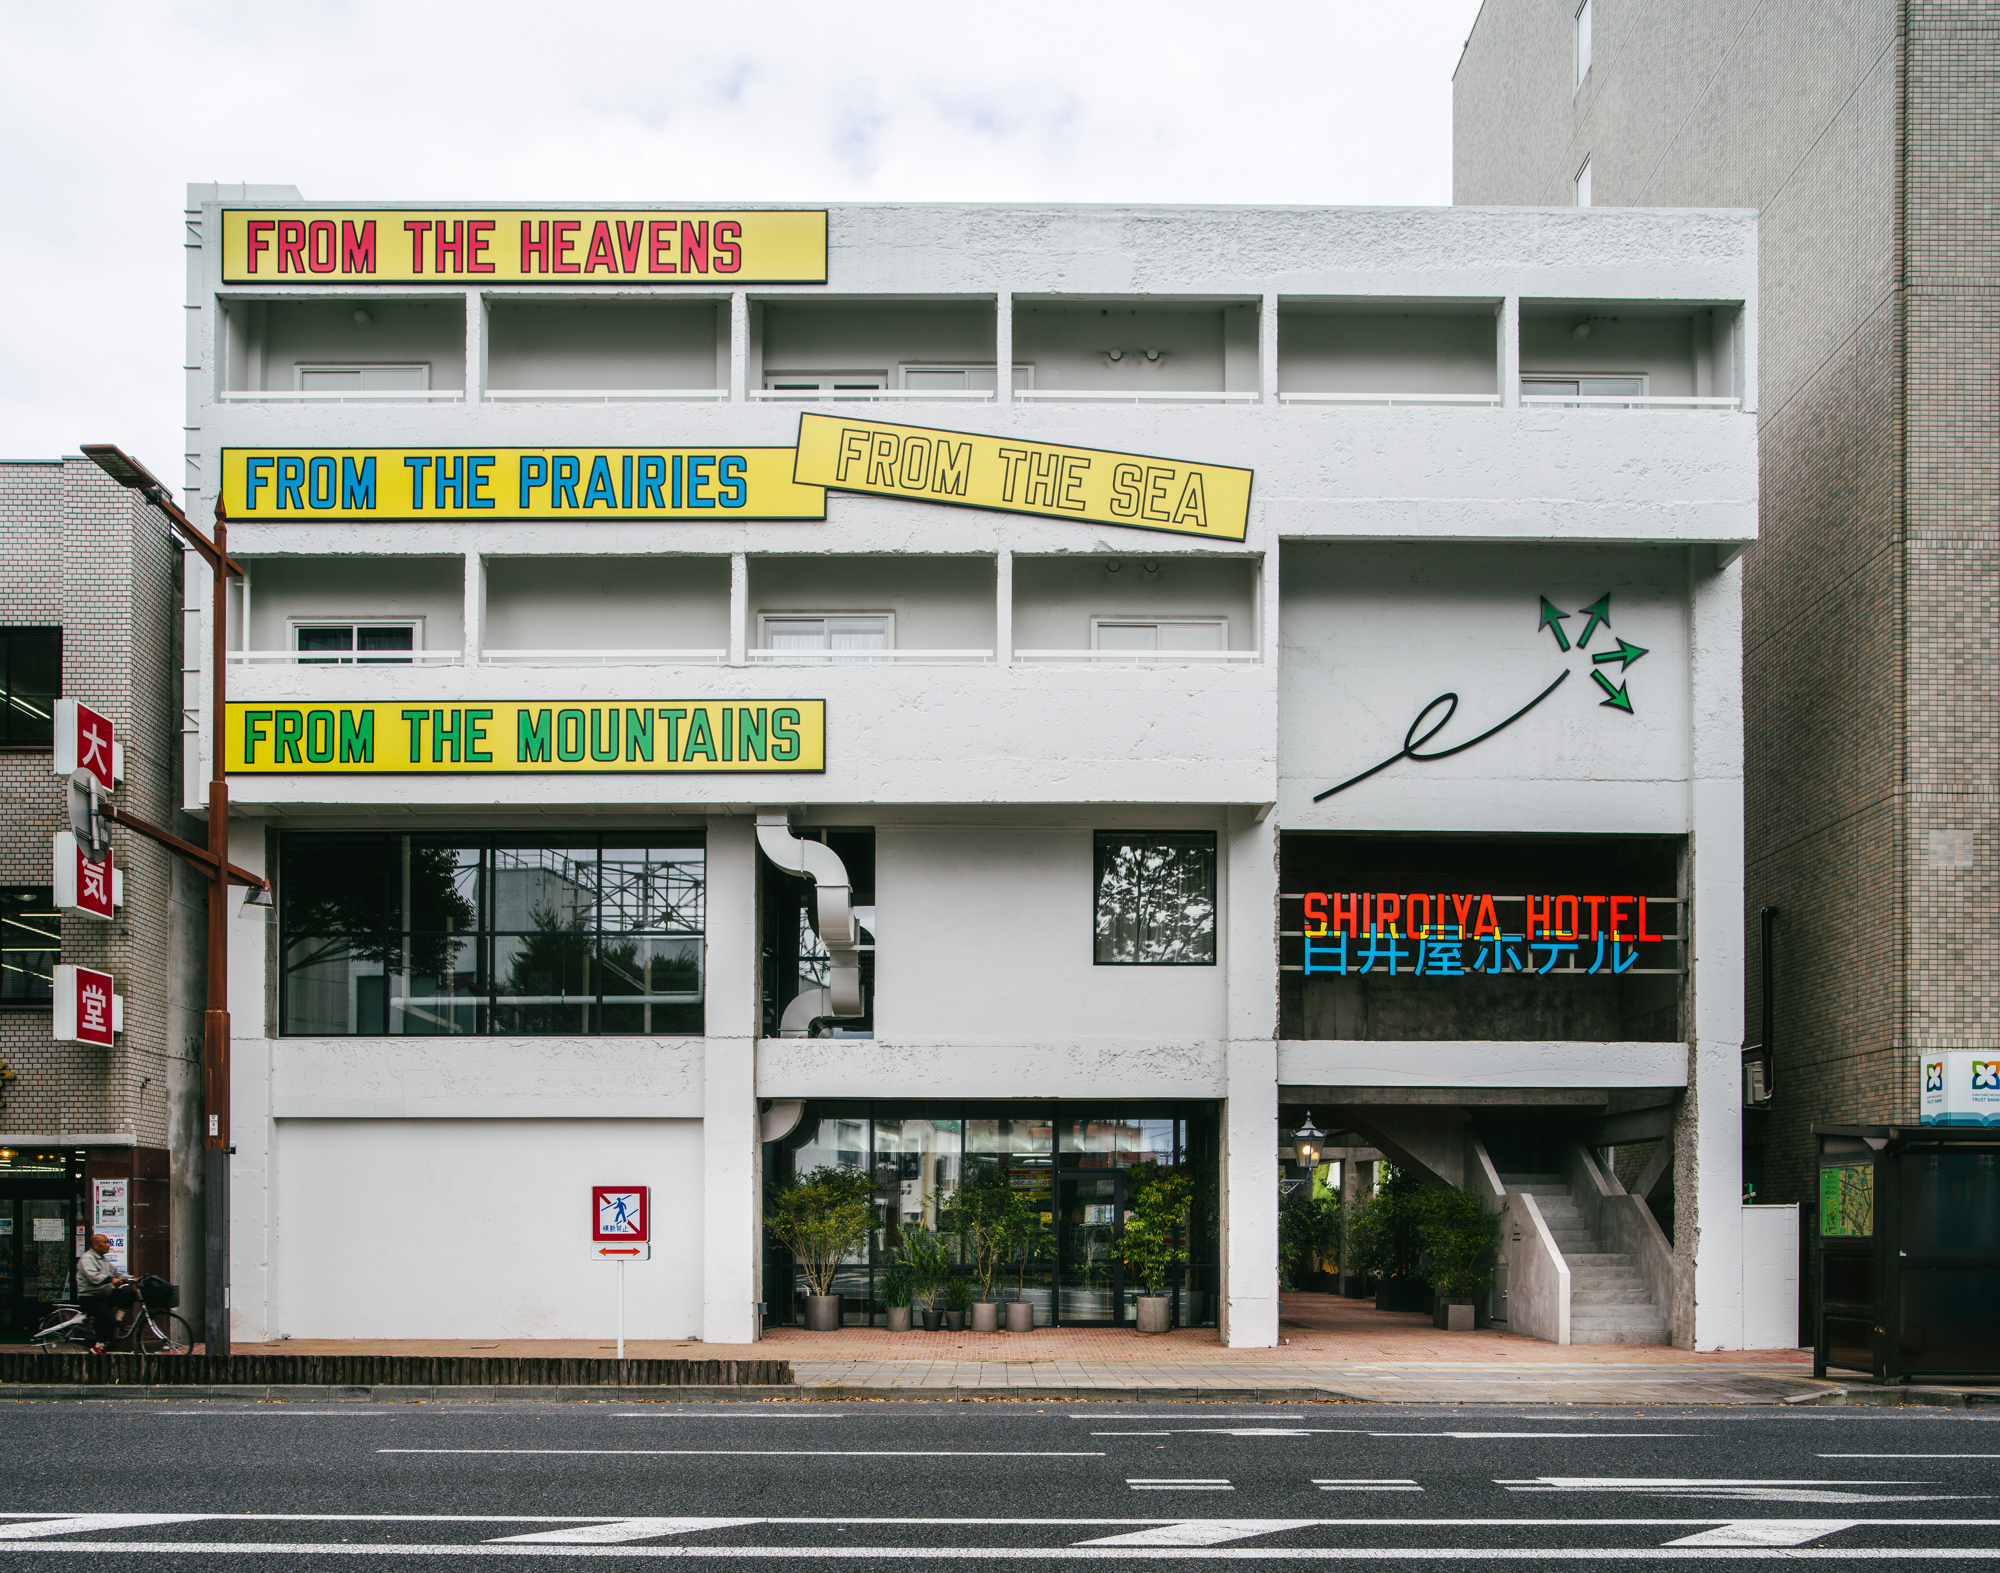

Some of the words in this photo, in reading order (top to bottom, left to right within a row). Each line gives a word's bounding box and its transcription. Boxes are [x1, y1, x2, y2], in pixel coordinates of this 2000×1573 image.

[247, 219, 377, 274] FROM
[404, 220, 496, 274] THE
[520, 220, 742, 274] HEAVENS
[246, 456, 377, 510] FROM
[403, 455, 496, 510] THE
[519, 455, 747, 509] PRAIRIES
[836, 428, 972, 496] FROM
[999, 447, 1091, 511] THE
[1110, 462, 1208, 527] SEA
[244, 709, 375, 765] FROM
[401, 709, 494, 763] THE
[517, 707, 801, 763] MOUNTAINS
[1303, 891, 1501, 941] SHIROIYA
[1526, 894, 1663, 943] HOTEL
[602, 1224, 629, 1233] 横断禁止
